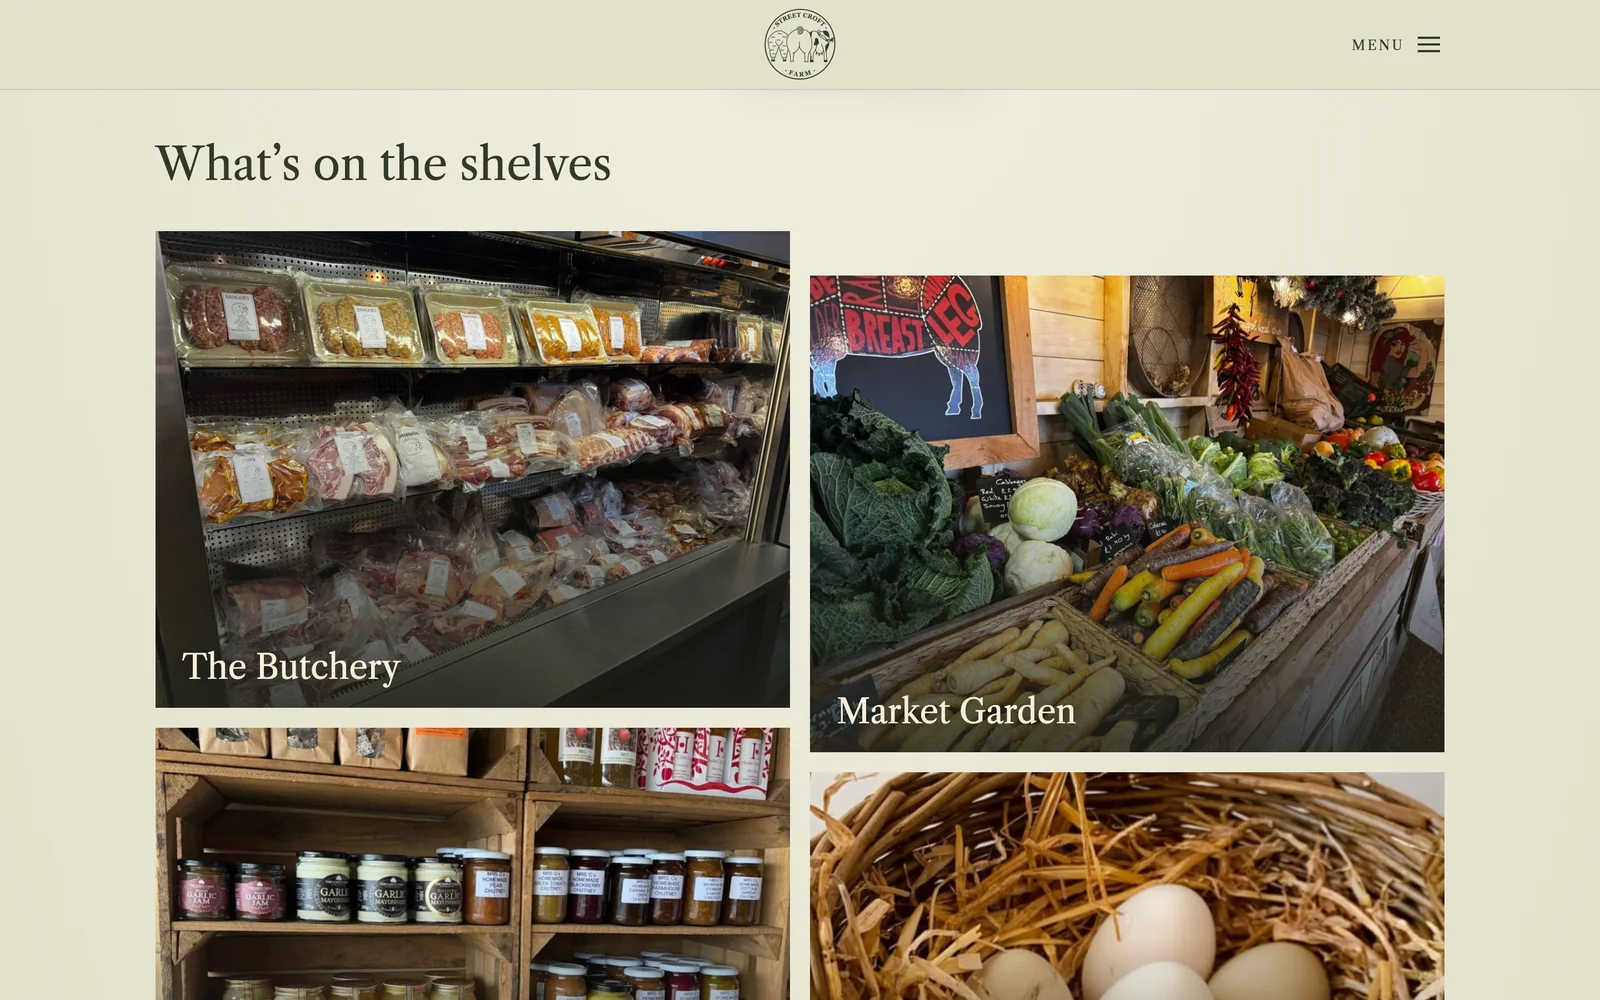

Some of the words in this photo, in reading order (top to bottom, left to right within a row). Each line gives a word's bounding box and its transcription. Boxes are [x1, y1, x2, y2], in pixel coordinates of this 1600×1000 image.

[926, 283, 980, 348] LEG
[843, 308, 925, 355] BREAST
[980, 487, 995, 495] Red
[981, 494, 1002, 502] White
[983, 503, 1006, 513] Savoy
[186, 891, 218, 900] GARLIC
[245, 894, 275, 902] GARLIC
